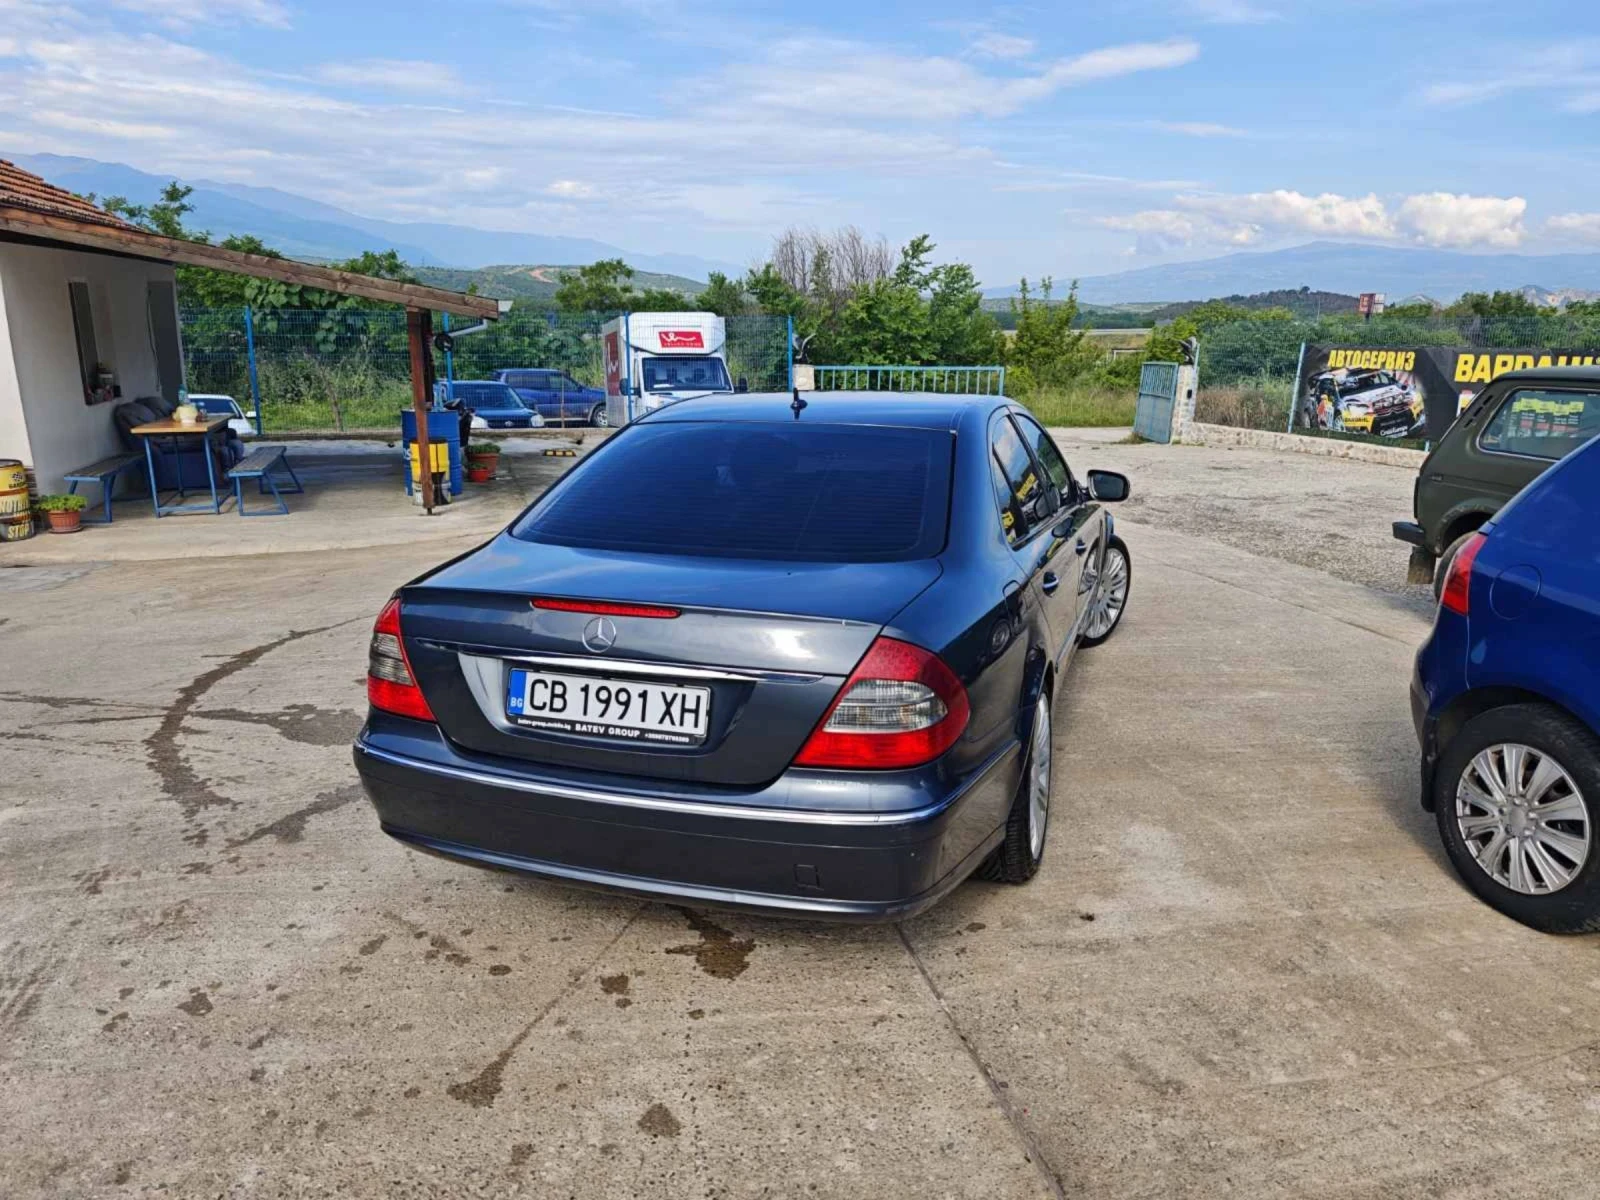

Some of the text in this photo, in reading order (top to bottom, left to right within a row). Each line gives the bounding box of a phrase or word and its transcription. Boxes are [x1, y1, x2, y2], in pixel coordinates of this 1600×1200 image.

[1327, 350, 1416, 371] АВТОСЕРВИЗ
[510, 696, 523, 708] BG
[530, 679, 701, 728] CB 1991 XH
[575, 723, 605, 734] BATEV
[608, 727, 641, 738] GROUP
